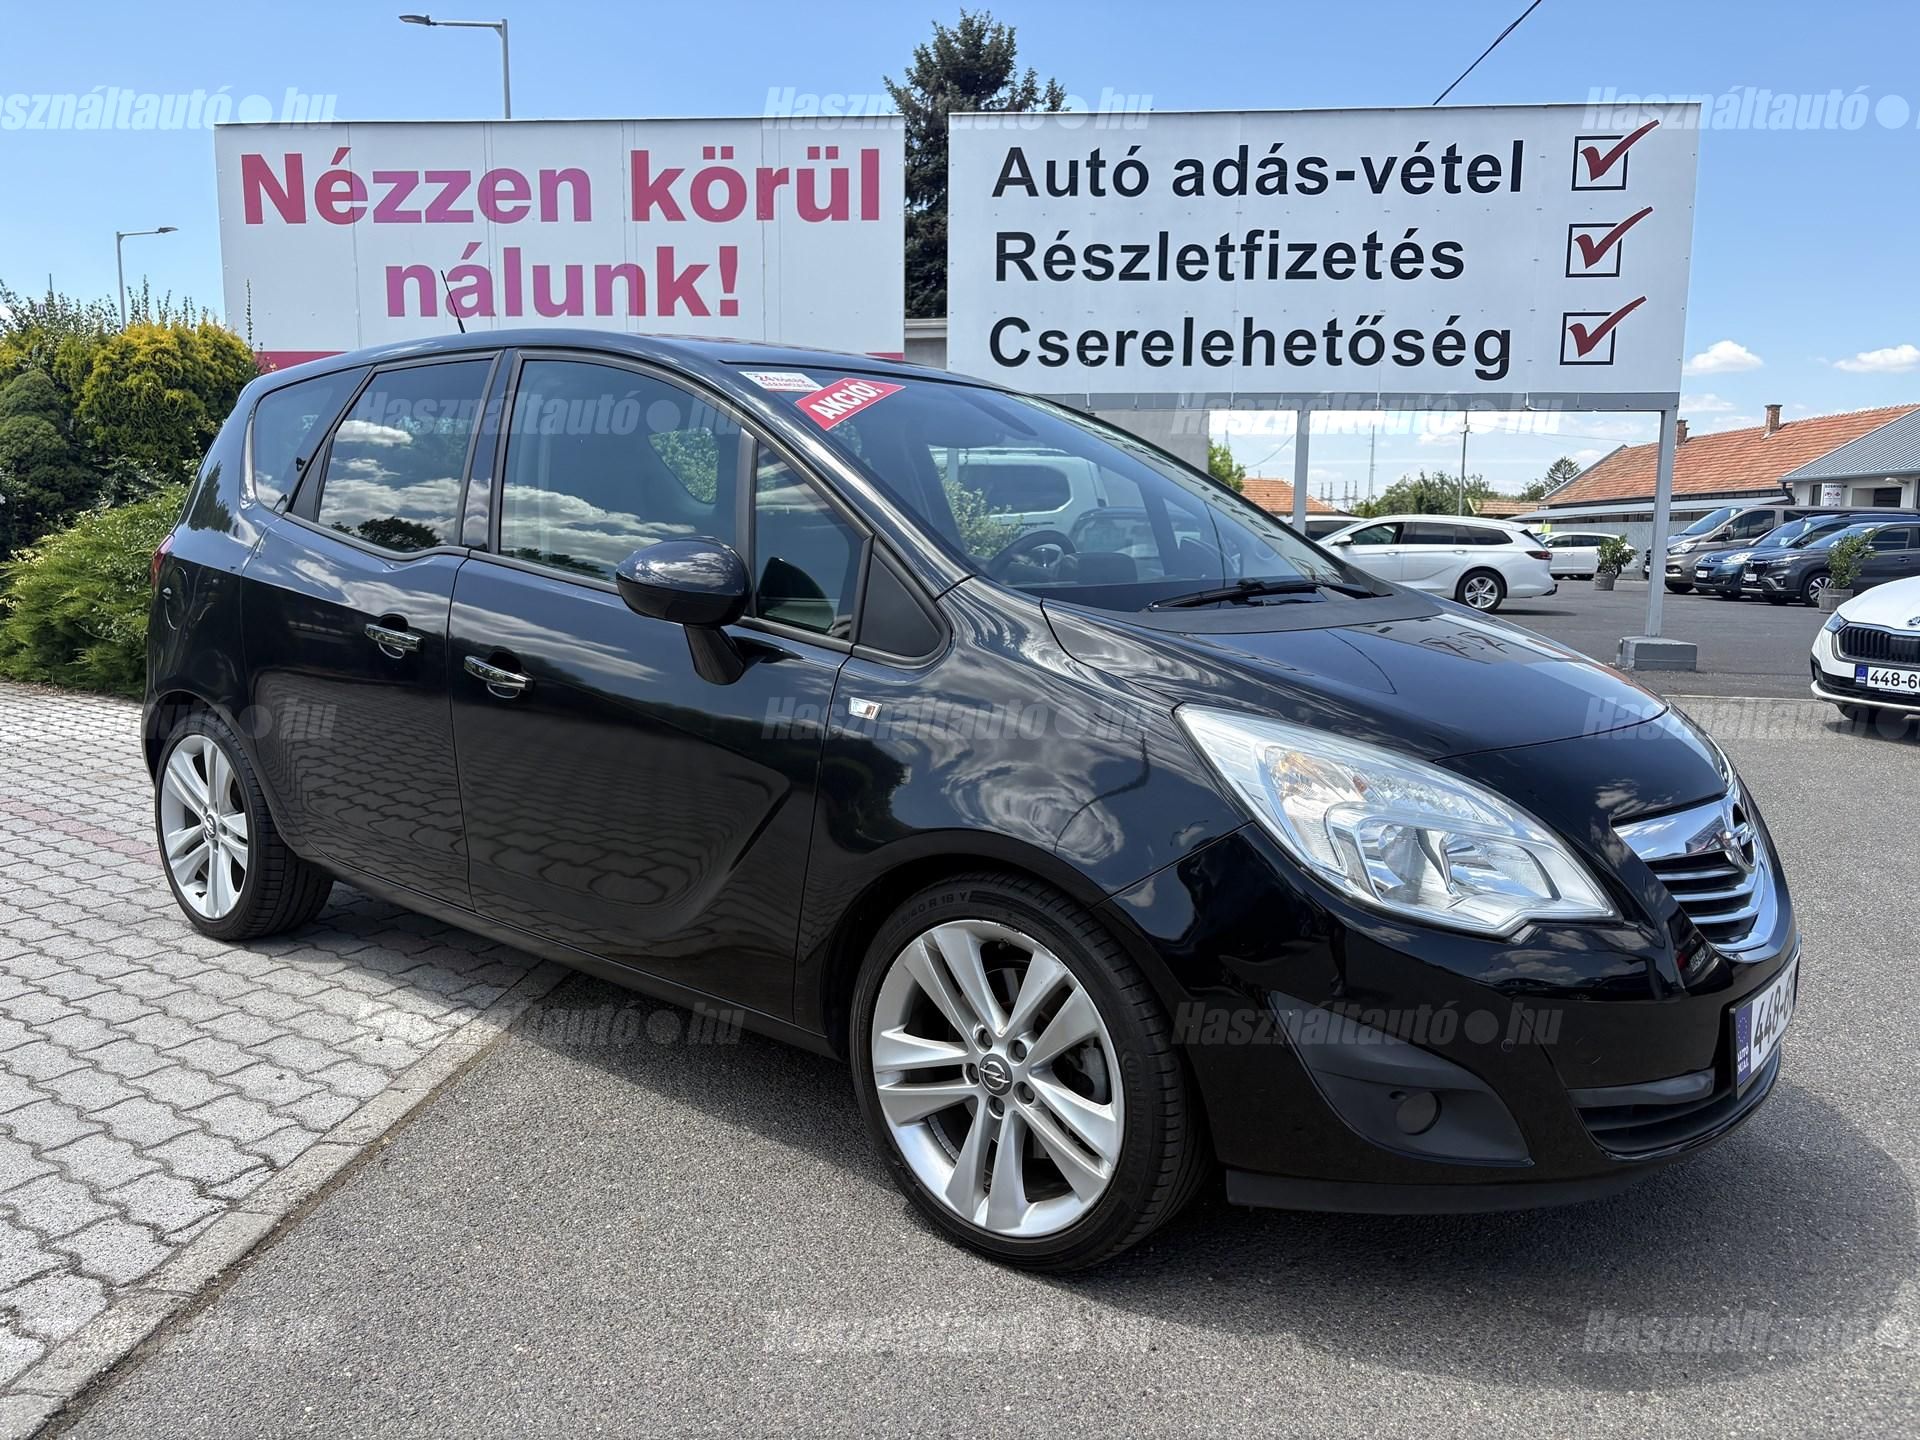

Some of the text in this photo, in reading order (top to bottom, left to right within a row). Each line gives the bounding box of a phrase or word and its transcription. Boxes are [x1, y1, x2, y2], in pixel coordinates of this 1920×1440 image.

[241, 146, 880, 225] Nézzen körül
[991, 139, 1524, 198] Autó adás-vétel
[386, 241, 739, 318] nálunk!
[995, 228, 1464, 282] Részletfizetés
[989, 314, 1511, 381] Cserelehetőség
[809, 381, 884, 420] AKCIÓ!
[1870, 669, 1920, 689] 448-6
